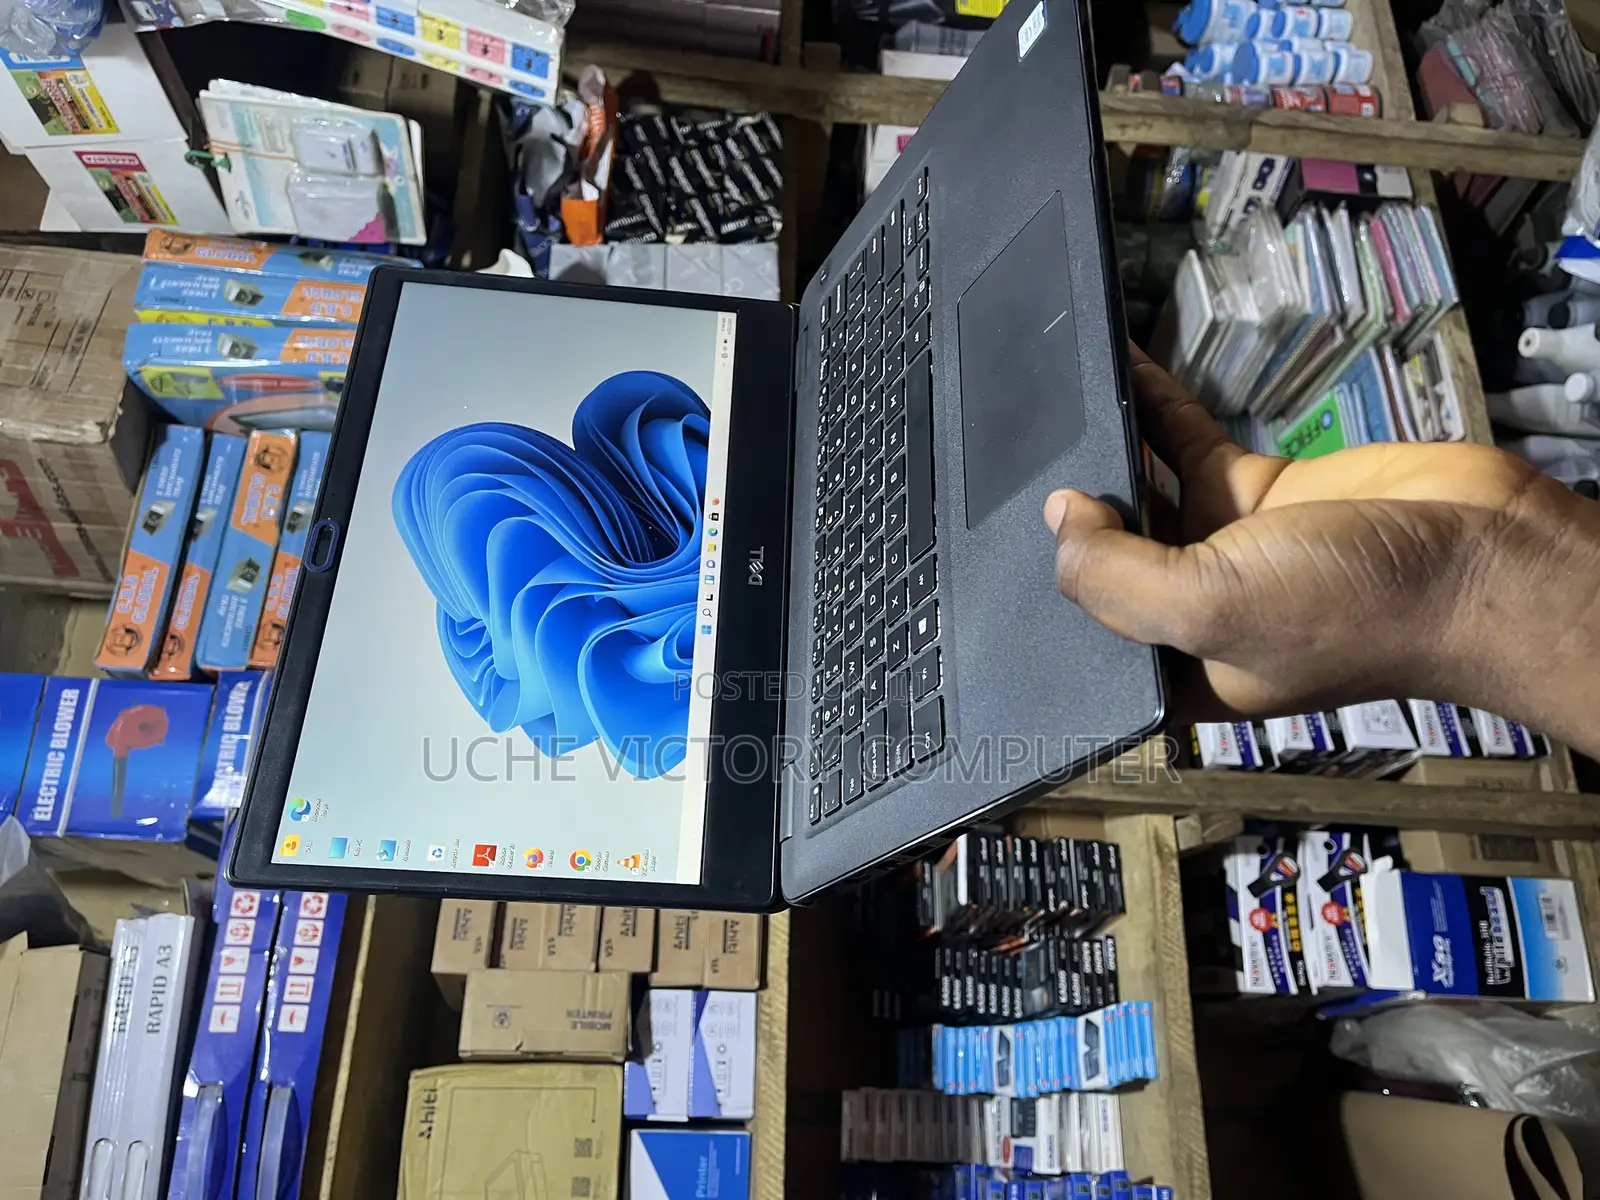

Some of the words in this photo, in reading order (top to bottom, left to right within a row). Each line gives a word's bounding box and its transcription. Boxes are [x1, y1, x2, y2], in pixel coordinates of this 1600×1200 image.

[748, 546, 764, 586] DELL
[32, 750, 65, 821] ELECTRIC
[49, 688, 80, 749] BLOWER
[870, 759, 878, 781] Caps
[155, 944, 173, 969] A3
[146, 975, 168, 1034] RAPID
[695, 1155, 708, 1198] Printer
